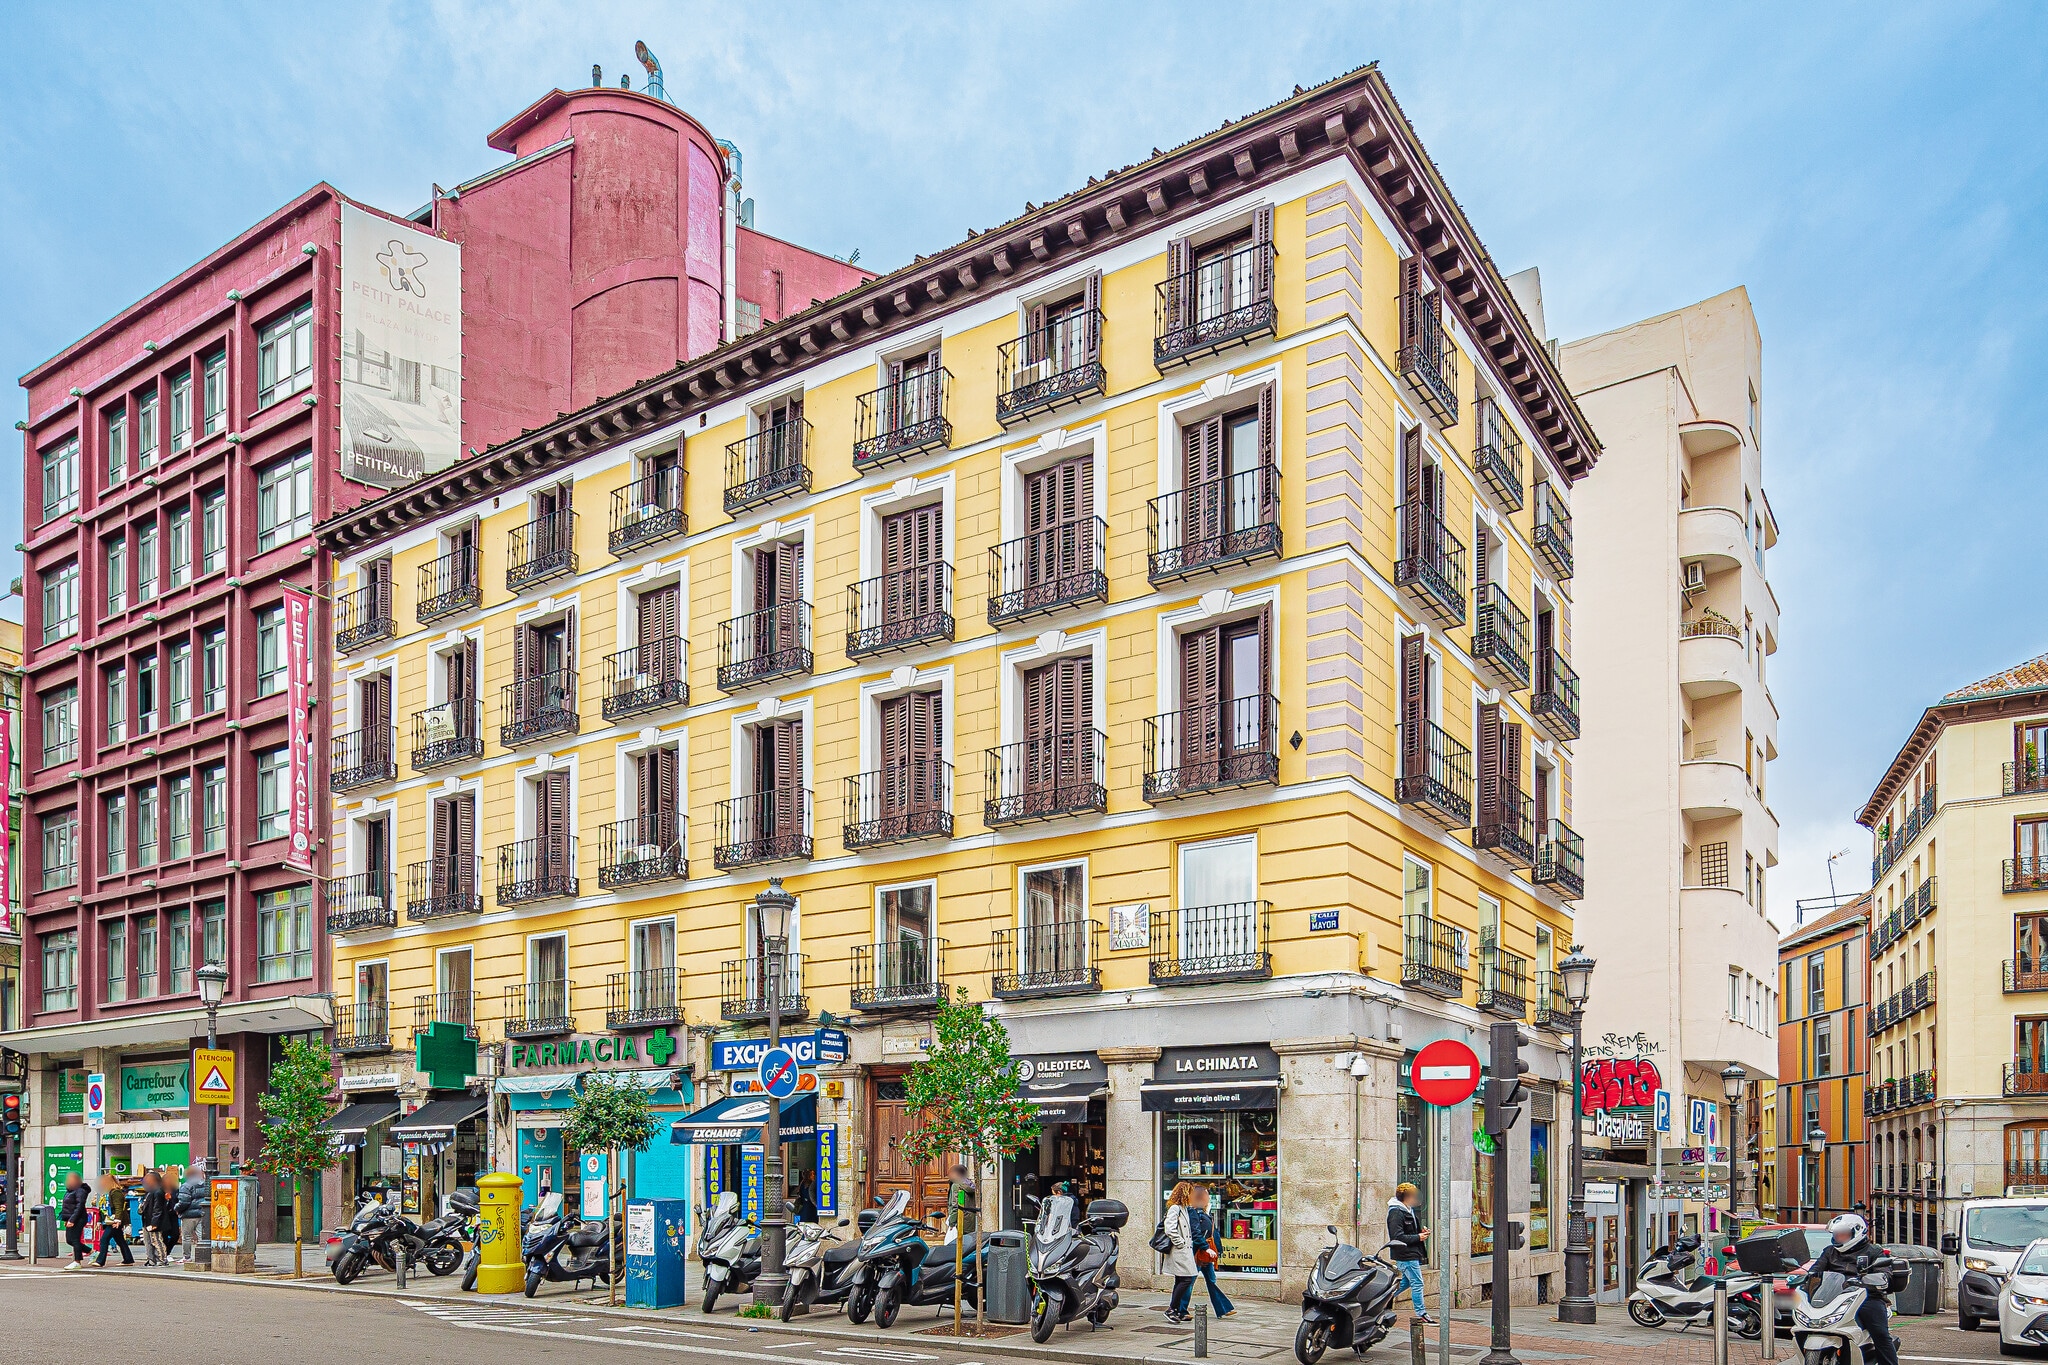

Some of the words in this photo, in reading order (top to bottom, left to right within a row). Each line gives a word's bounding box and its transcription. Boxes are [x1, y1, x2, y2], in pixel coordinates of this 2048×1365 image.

[352, 280, 393, 305] PETIT
[398, 297, 452, 326] PALACE
[365, 312, 401, 333] PLAZA
[404, 326, 440, 345] MAYOR
[291, 599, 305, 702] PETIT
[293, 707, 307, 828] PALACE
[1311, 920, 1337, 930] MAYOR
[1117, 931, 1142, 940] CALLE
[1114, 938, 1145, 949] MAYOR
[1601, 1031, 1648, 1050] KREME
[198, 1053, 232, 1063] ATENCION
[512, 1036, 638, 1068] FARMACIA
[723, 1041, 816, 1066] EXCHNG
[1037, 1059, 1091, 1072] OLEOTECA
[1176, 1059, 1194, 1072] LA
[1196, 1055, 1258, 1071] CHINATA
[127, 1071, 176, 1091] Carrefour
[1037, 1071, 1065, 1079] GOURMET
[147, 1091, 175, 1104] express
[1193, 1095, 1213, 1104] virgin
[1213, 1094, 1230, 1102] olive
[1231, 1093, 1241, 1101] oil
[169, 1130, 188, 1138] FESTIVOS
[692, 1128, 743, 1138] EXCHANGE
[779, 1126, 814, 1136] EXCHANGE
[821, 1131, 832, 1207] CHANGE
[1237, 1252, 1253, 1260] vida
